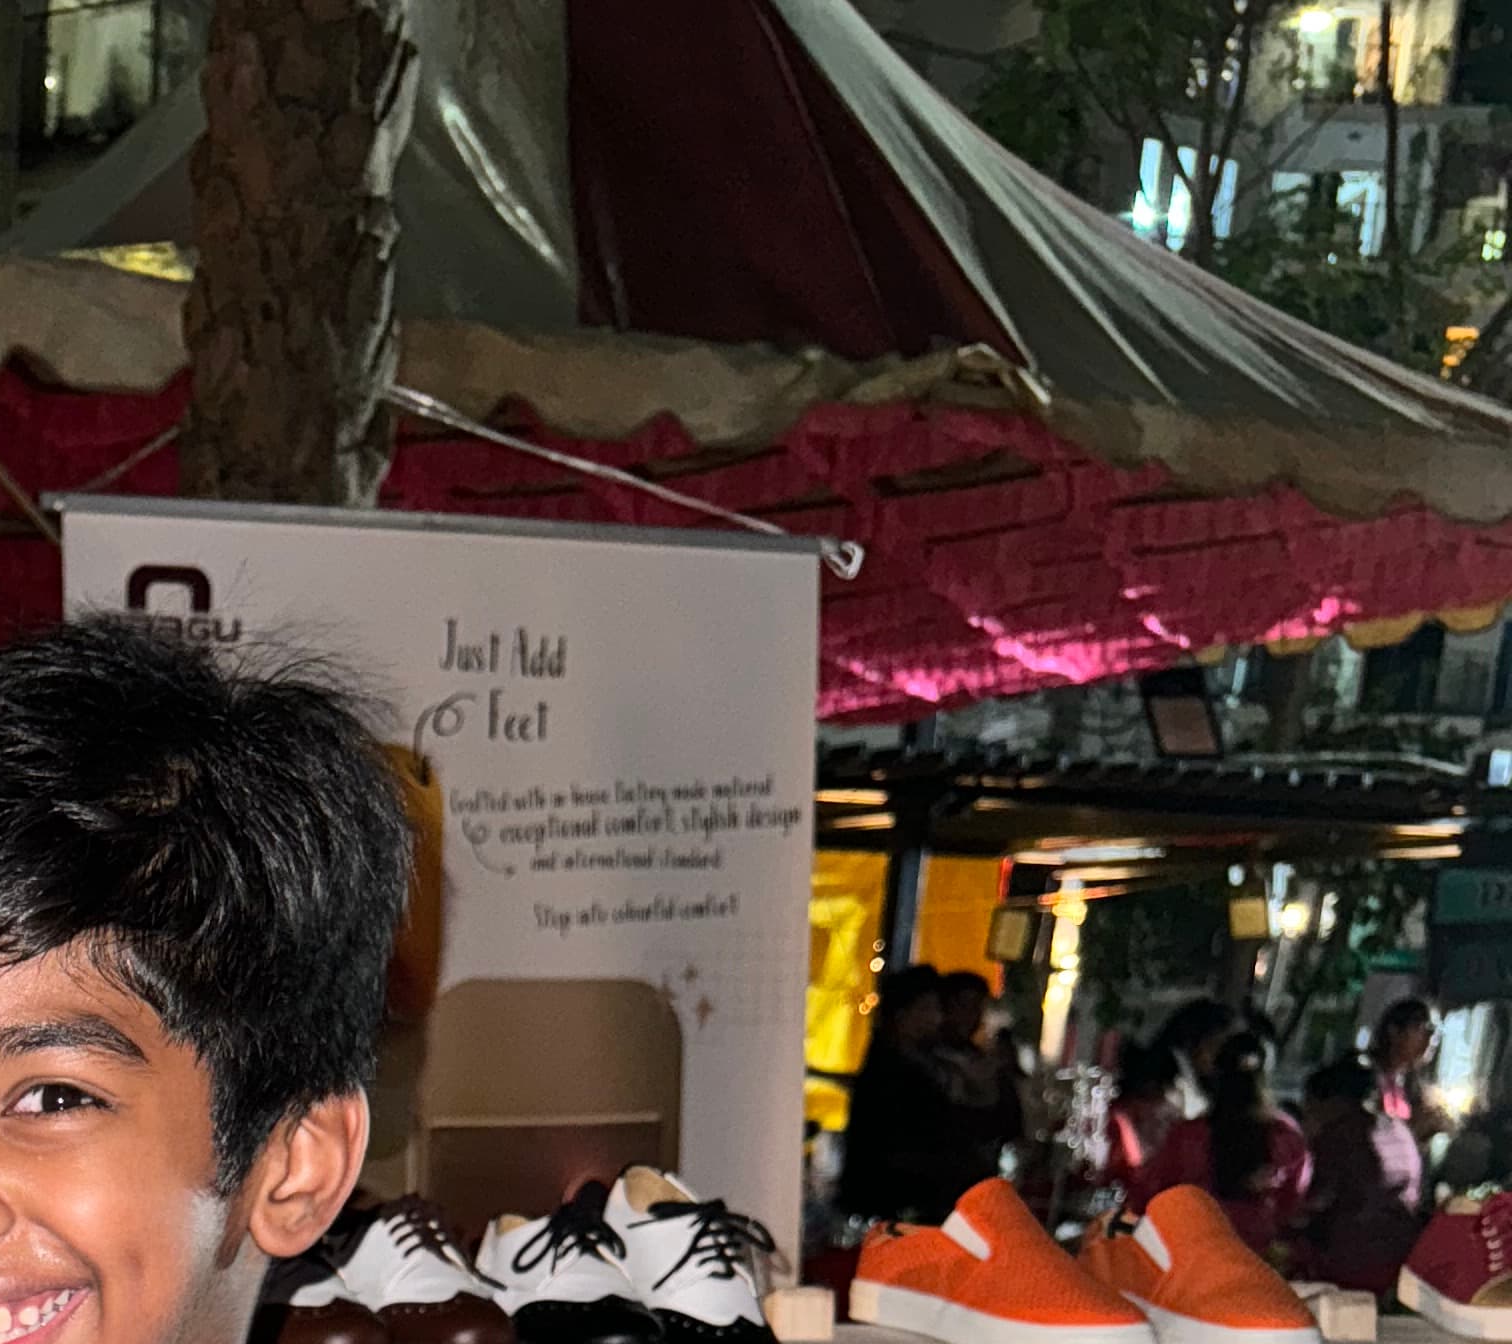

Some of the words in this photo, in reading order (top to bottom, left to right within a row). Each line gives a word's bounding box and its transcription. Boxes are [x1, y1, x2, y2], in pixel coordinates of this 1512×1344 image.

[439, 617, 500, 673] Just
[510, 625, 568, 679] Add
[487, 688, 548, 742] Feet
[498, 808, 600, 850] exceptional
[533, 903, 571, 939] Step
